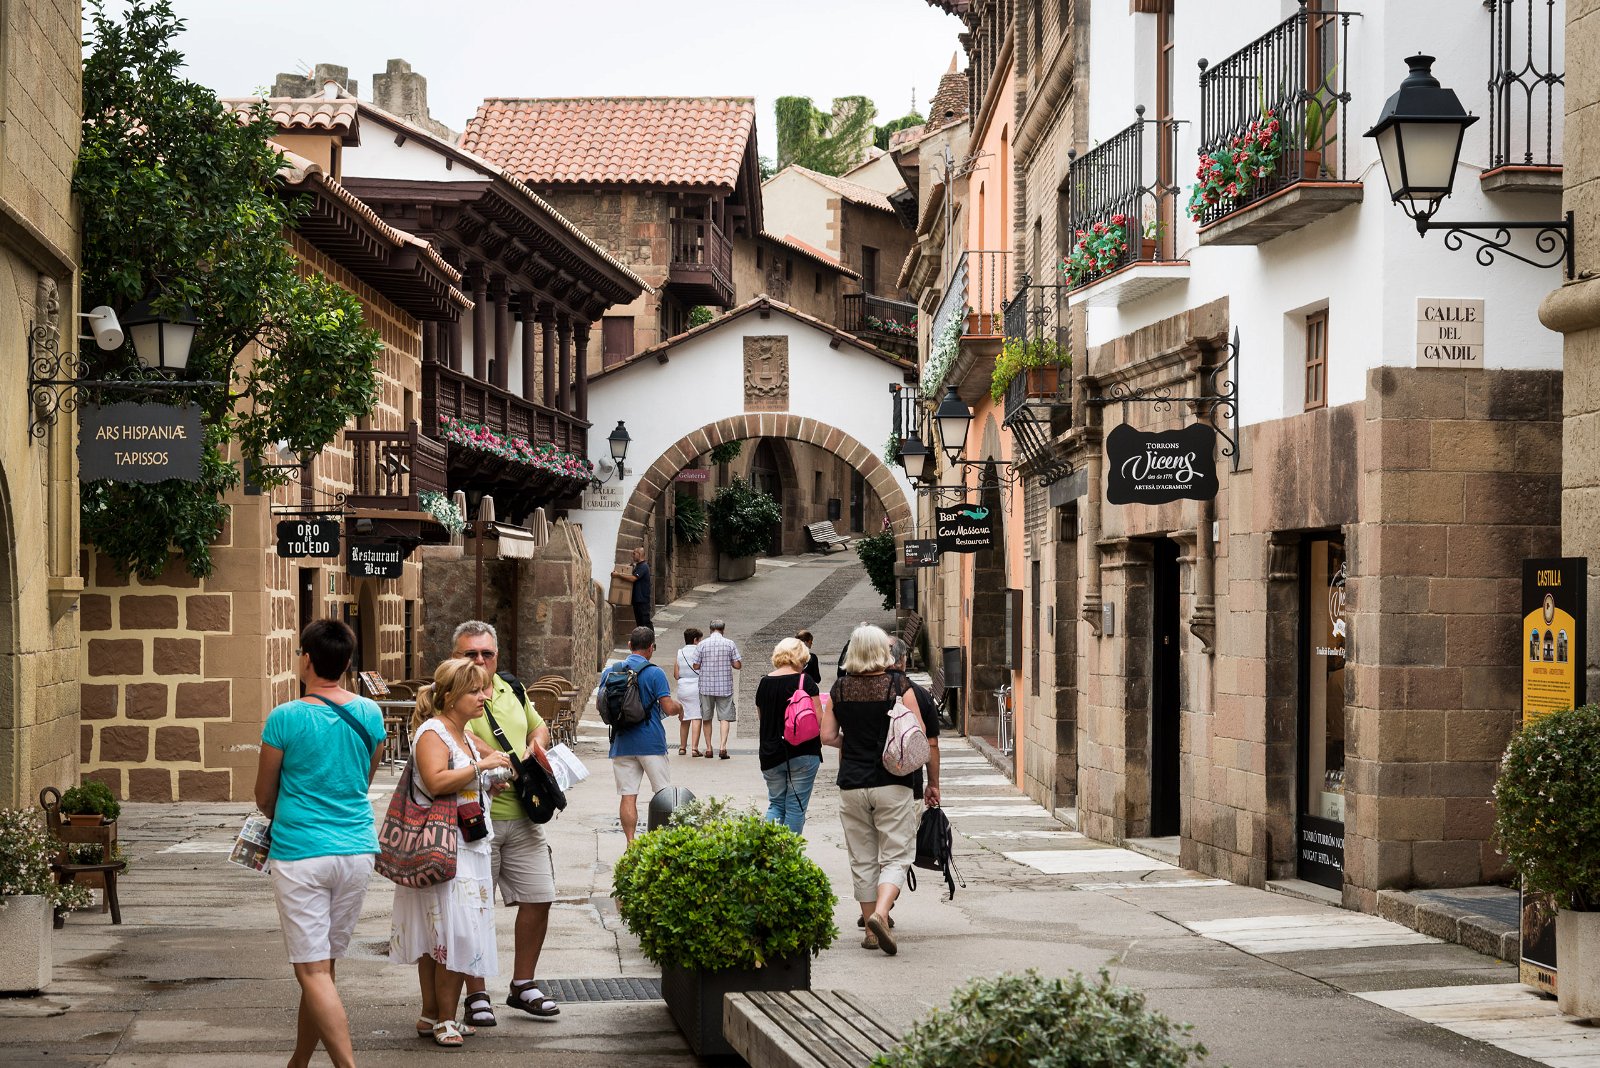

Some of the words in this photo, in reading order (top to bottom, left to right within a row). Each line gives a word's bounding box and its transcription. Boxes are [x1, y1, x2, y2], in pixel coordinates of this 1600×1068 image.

[1424, 306, 1477, 322] CALLE
[1439, 326, 1462, 340] DEL
[1424, 345, 1477, 361] CANDIL
[95, 425, 119, 440] ARS
[123, 424, 187, 440] HISPANIÆ
[114, 451, 169, 466] TAPISSOS
[1121, 450, 1205, 483] Vicens
[939, 512, 958, 522] Bar
[297, 524, 320, 536] ORO
[938, 526, 955, 537] Can
[304, 535, 312, 543] DE
[955, 537, 990, 545] Restaurant
[287, 541, 330, 554] TOLEDO
[351, 546, 400, 563] Restaurant
[364, 562, 388, 575] Bar
[1537, 569, 1562, 587] CASTILLA
